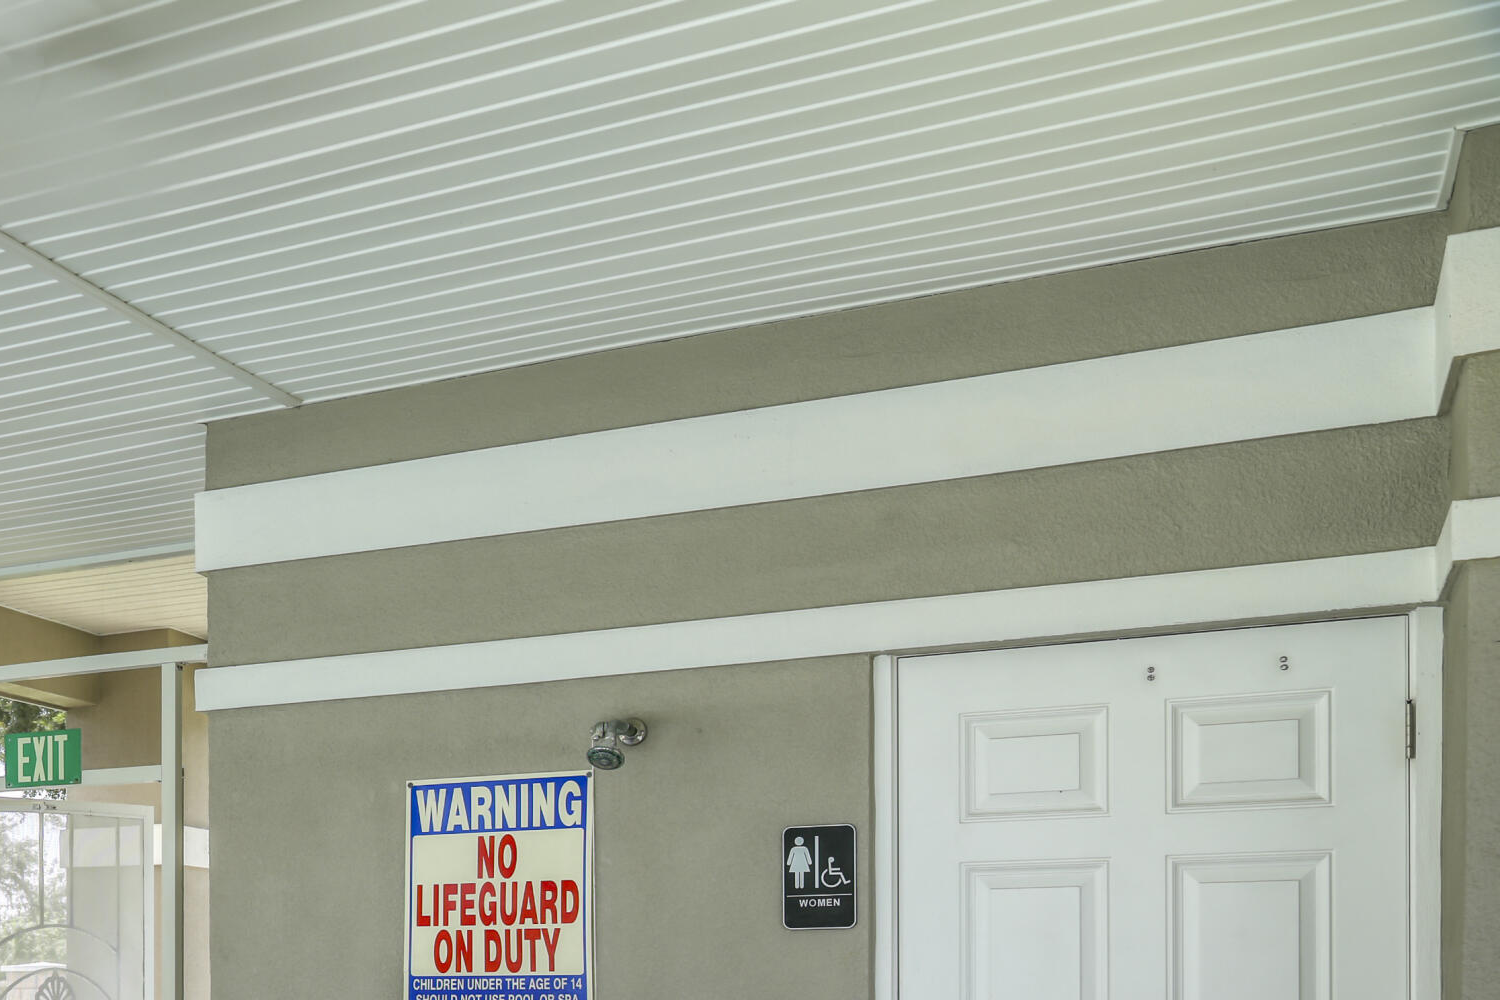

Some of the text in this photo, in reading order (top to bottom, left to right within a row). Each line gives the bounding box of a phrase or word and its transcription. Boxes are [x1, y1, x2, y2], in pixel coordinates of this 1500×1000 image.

[18, 734, 68, 783] EXIT
[416, 780, 582, 832] WARNING
[478, 834, 517, 879] NO
[416, 880, 579, 926] LIFEGUARD
[799, 898, 840, 907] WOMEN
[434, 928, 560, 973] ON DUTY
[413, 978, 582, 990] CHILDREN UNDER THE AGE OF 14
